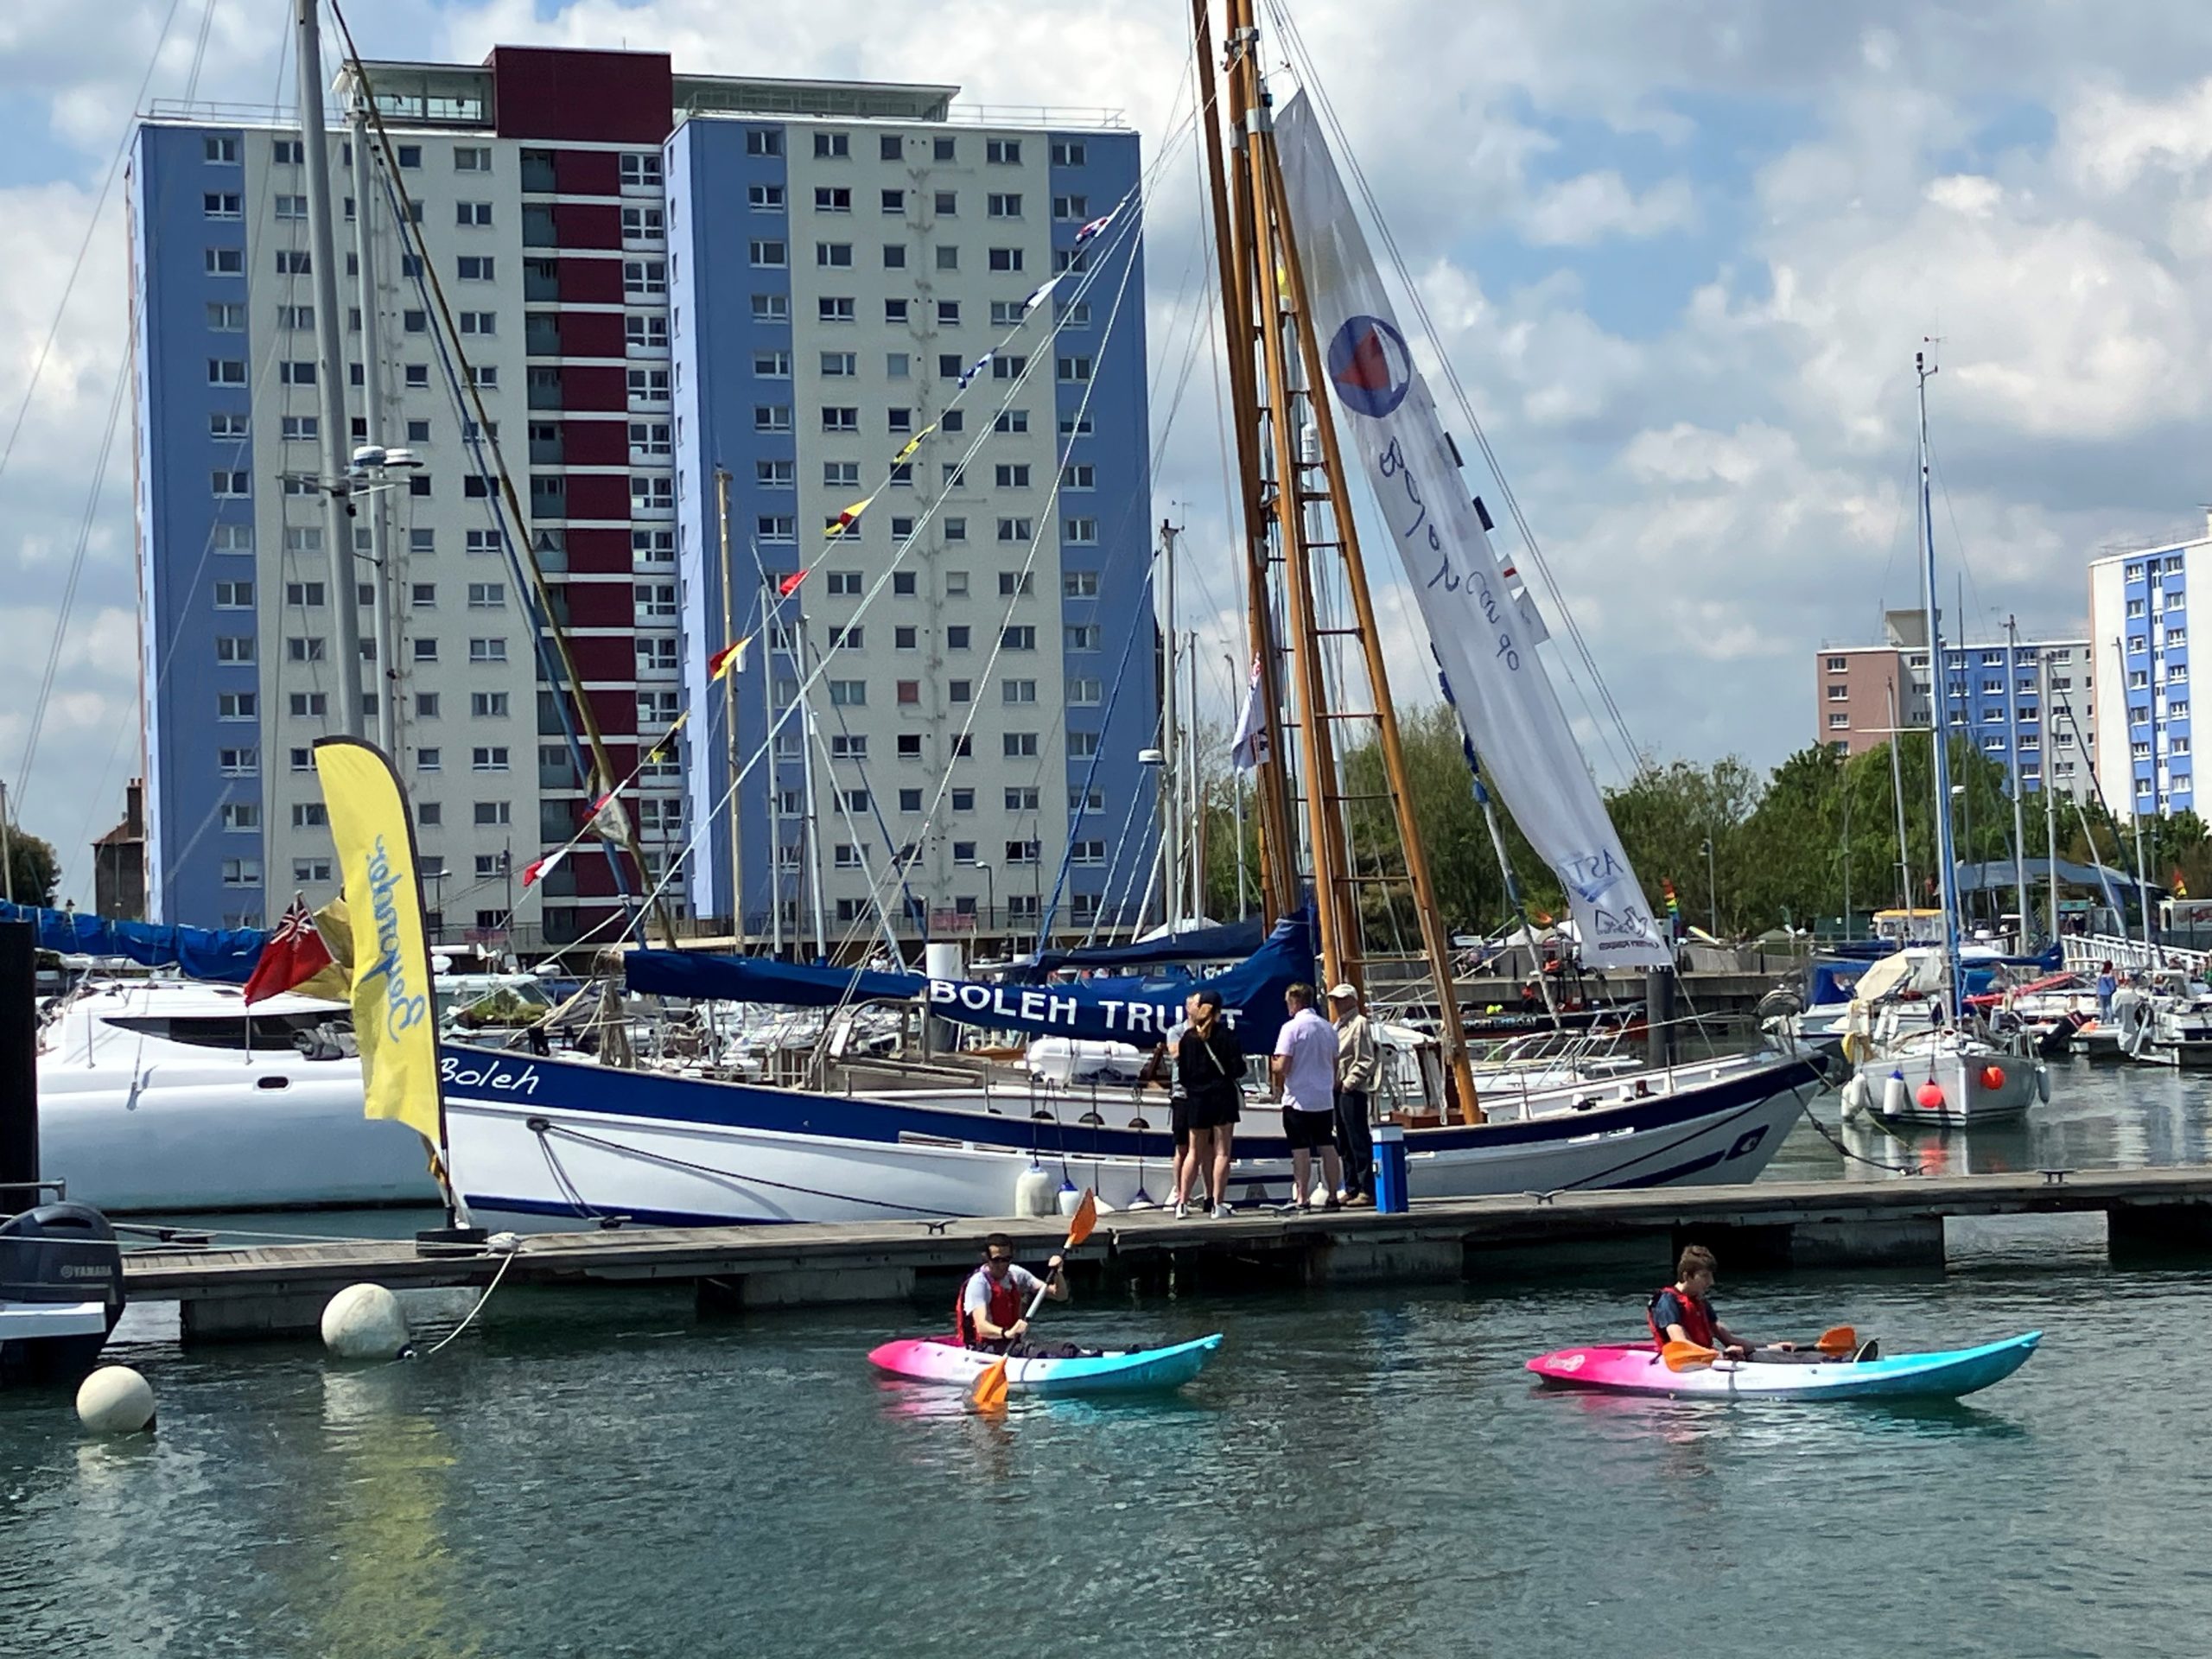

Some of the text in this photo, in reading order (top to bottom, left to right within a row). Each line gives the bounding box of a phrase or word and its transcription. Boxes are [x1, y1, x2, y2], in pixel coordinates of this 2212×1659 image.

[929, 978, 1243, 1033] BOLEH TRUT
[440, 1057, 540, 1095] Boleh
